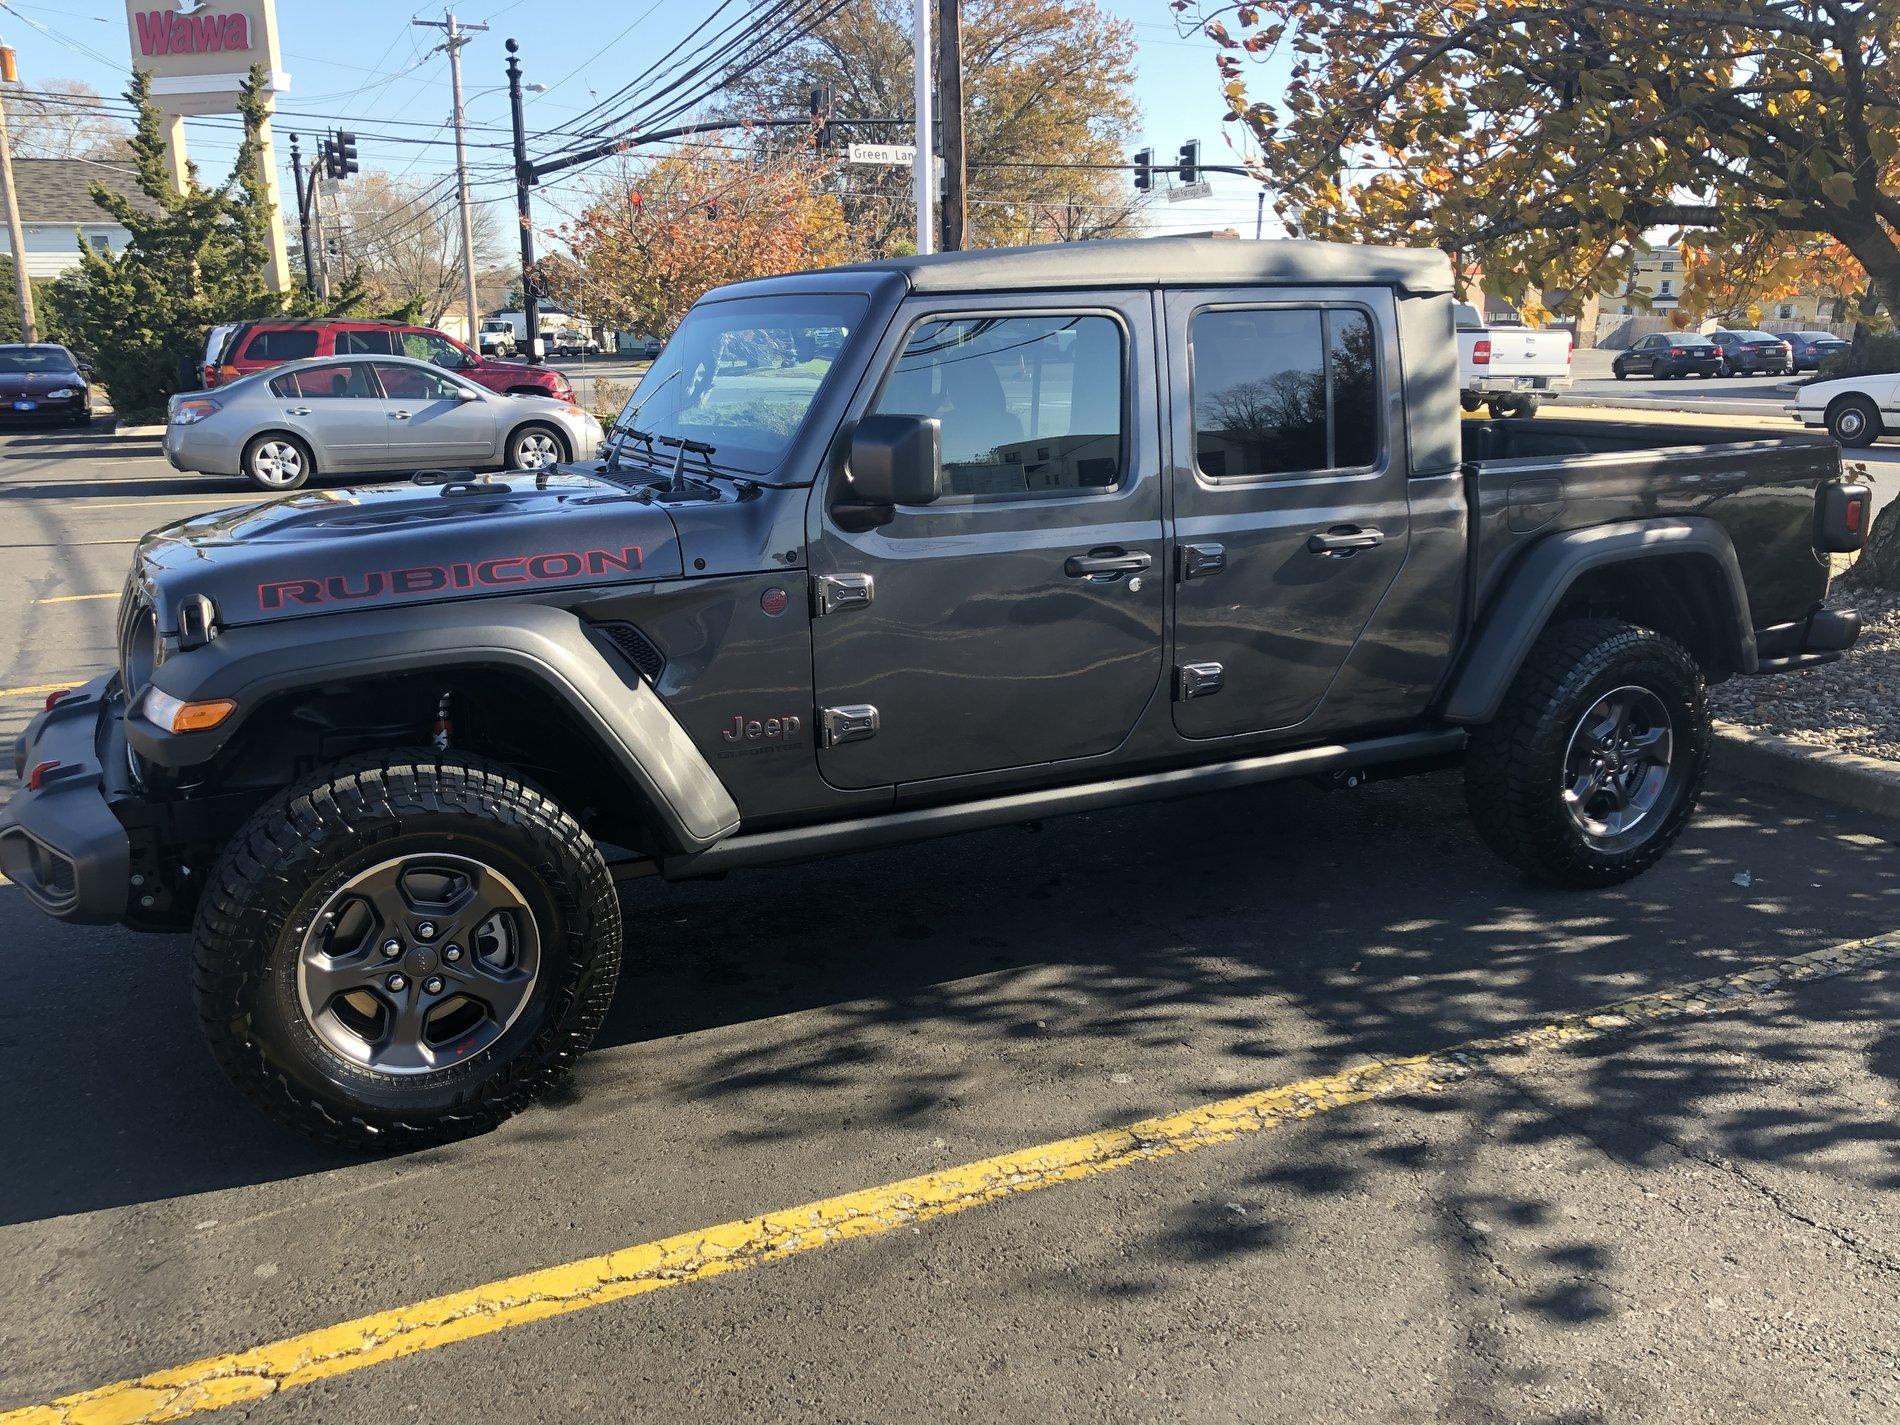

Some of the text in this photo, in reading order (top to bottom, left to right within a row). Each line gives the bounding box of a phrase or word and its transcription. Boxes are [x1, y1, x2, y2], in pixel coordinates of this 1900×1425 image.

[135, 9, 249, 55] Wawa
[854, 148, 915, 161] Green Lan
[257, 545, 643, 610] RUBICON
[722, 715, 801, 742] Jeep
